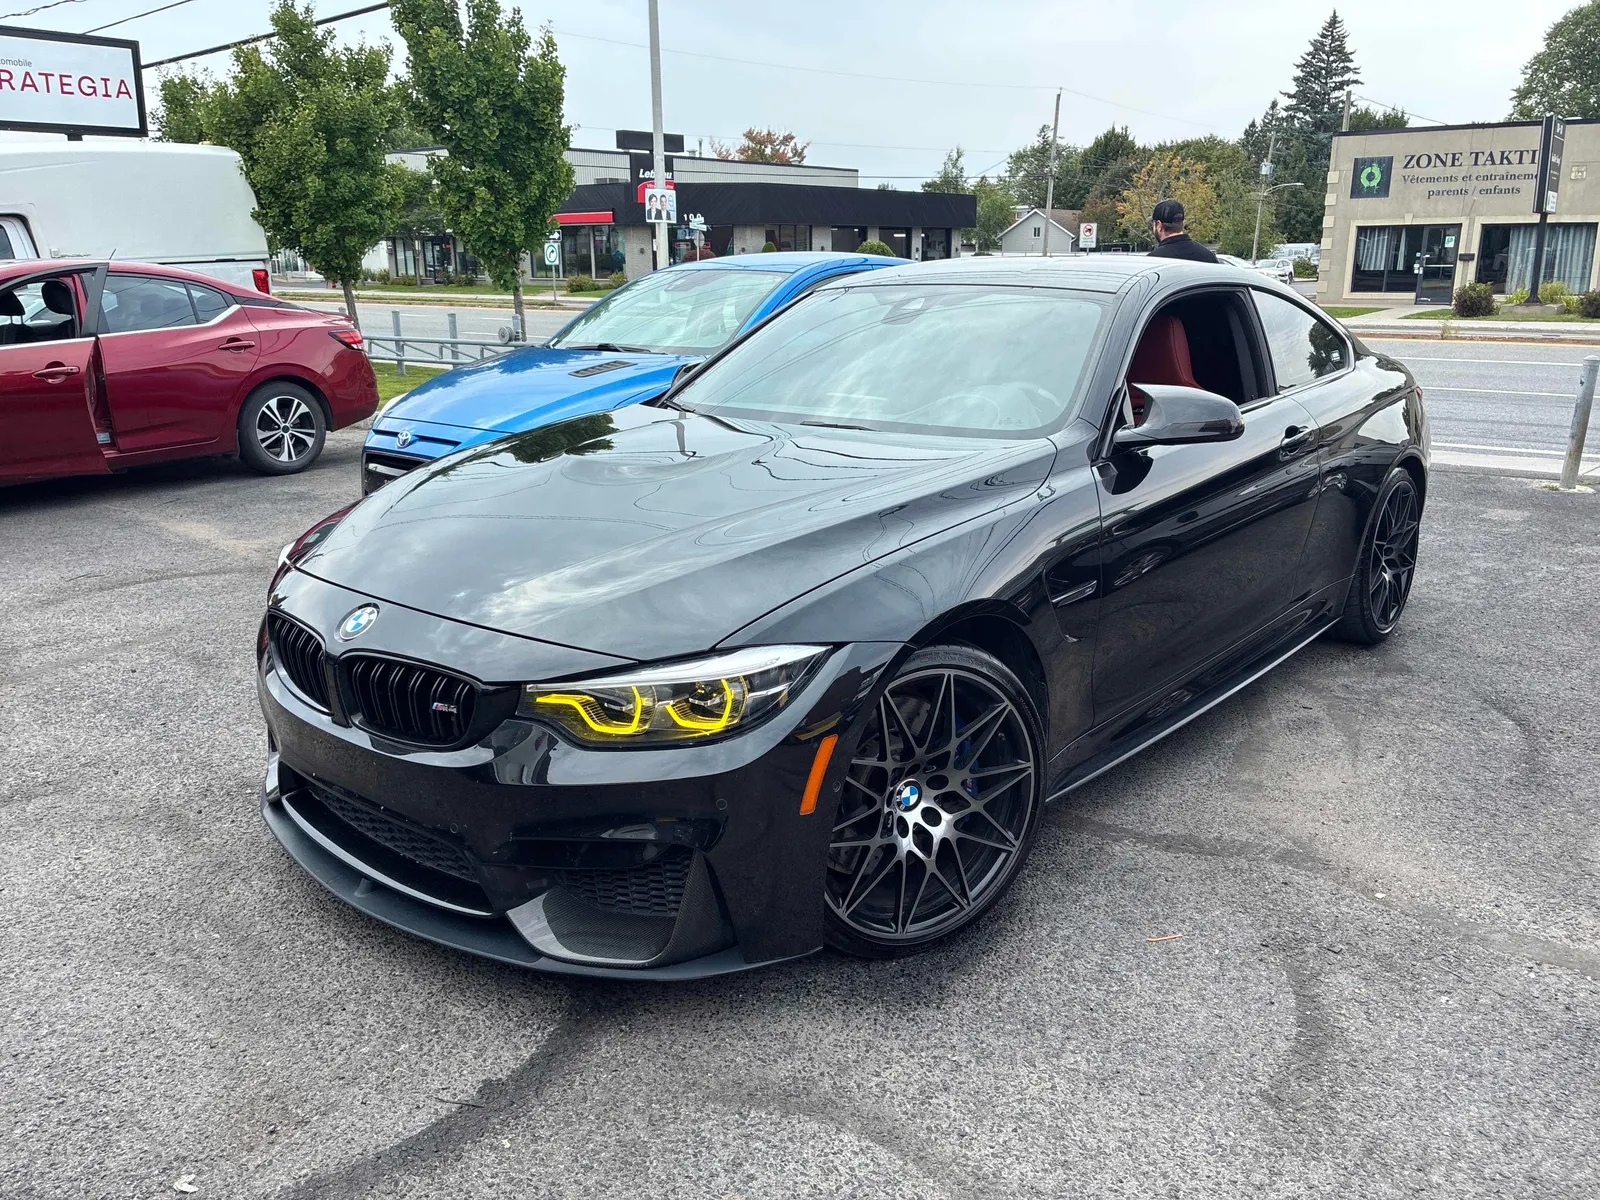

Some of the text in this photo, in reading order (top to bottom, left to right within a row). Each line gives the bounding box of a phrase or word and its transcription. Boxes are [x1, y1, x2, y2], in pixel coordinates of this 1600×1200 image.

[0, 58, 32, 67] omobile
[0, 68, 133, 100] RATEGIA
[1403, 152, 1463, 169] ZONE
[1402, 174, 1459, 184] Vêtements
[1461, 173, 1473, 182] et
[1427, 187, 1470, 199] parents
[1479, 184, 1521, 195] enfants
